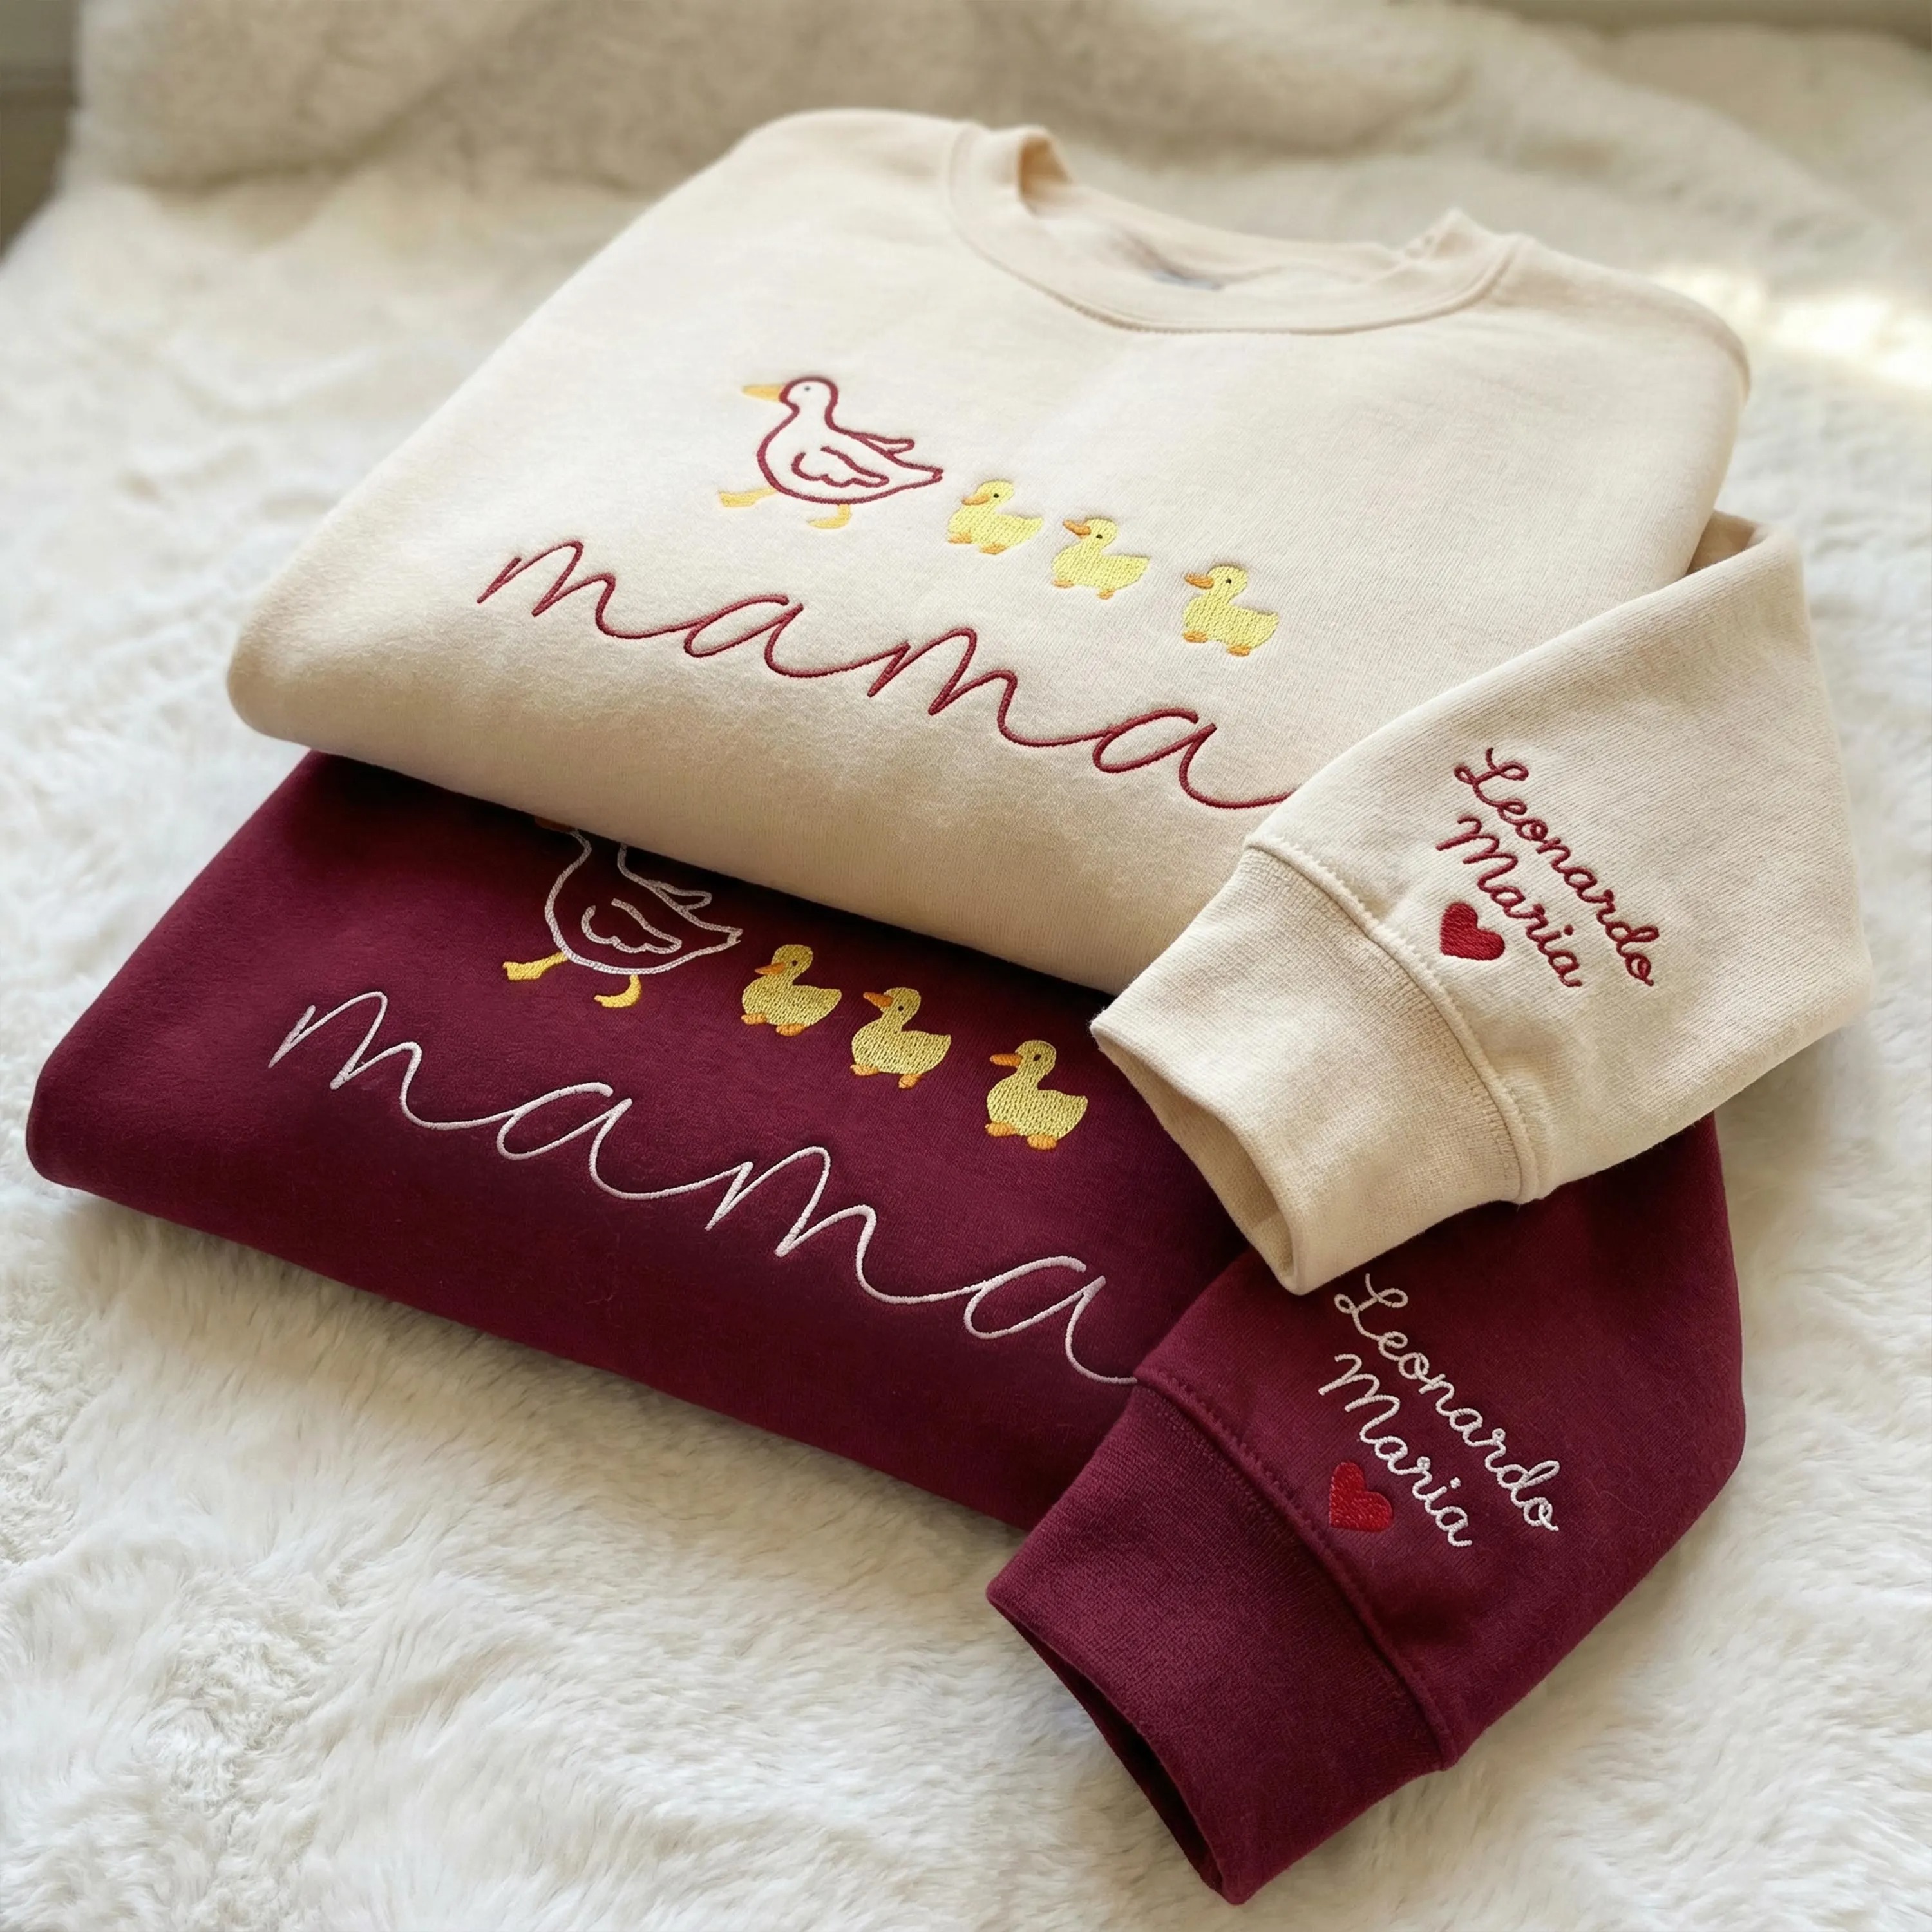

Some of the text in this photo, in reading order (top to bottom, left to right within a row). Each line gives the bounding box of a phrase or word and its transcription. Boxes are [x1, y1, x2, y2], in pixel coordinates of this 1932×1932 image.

[477, 540, 1300, 808] mama
[1435, 815, 1582, 987] Maria
[1454, 748, 1660, 986] Leonardo
[269, 991, 1137, 1385] mama
[1318, 1354, 1472, 1547] Maria
[1334, 1273, 1560, 1531] Leonardo
